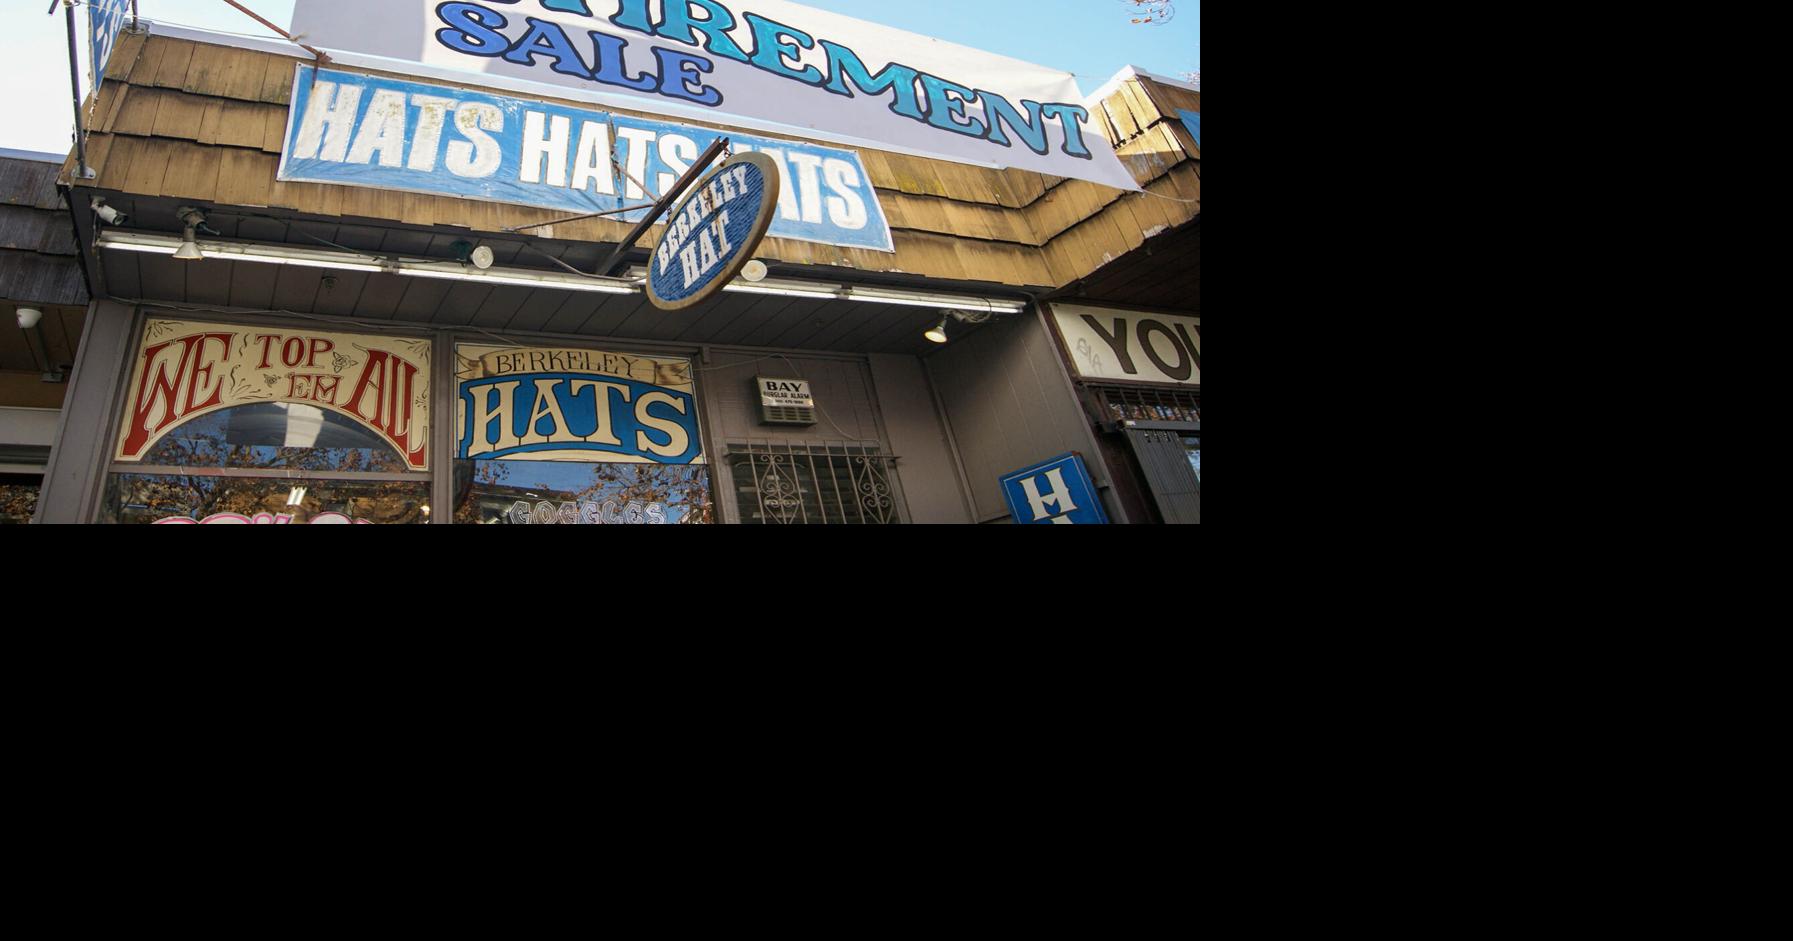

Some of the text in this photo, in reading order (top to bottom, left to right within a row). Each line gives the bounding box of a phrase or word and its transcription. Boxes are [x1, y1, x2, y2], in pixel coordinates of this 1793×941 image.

[435, 1, 724, 107] SALE
[293, 80, 505, 178] HATS
[520, 110, 700, 207] HATS
[657, 165, 748, 276] BERKELEY
[679, 209, 732, 290] HAT
[254, 333, 336, 370] TOP
[496, 350, 639, 378] BERKELEY
[766, 381, 801, 392] BAY
[121, 332, 237, 457] WE
[468, 378, 690, 458] HATS
[509, 500, 669, 524] GOGGLES
